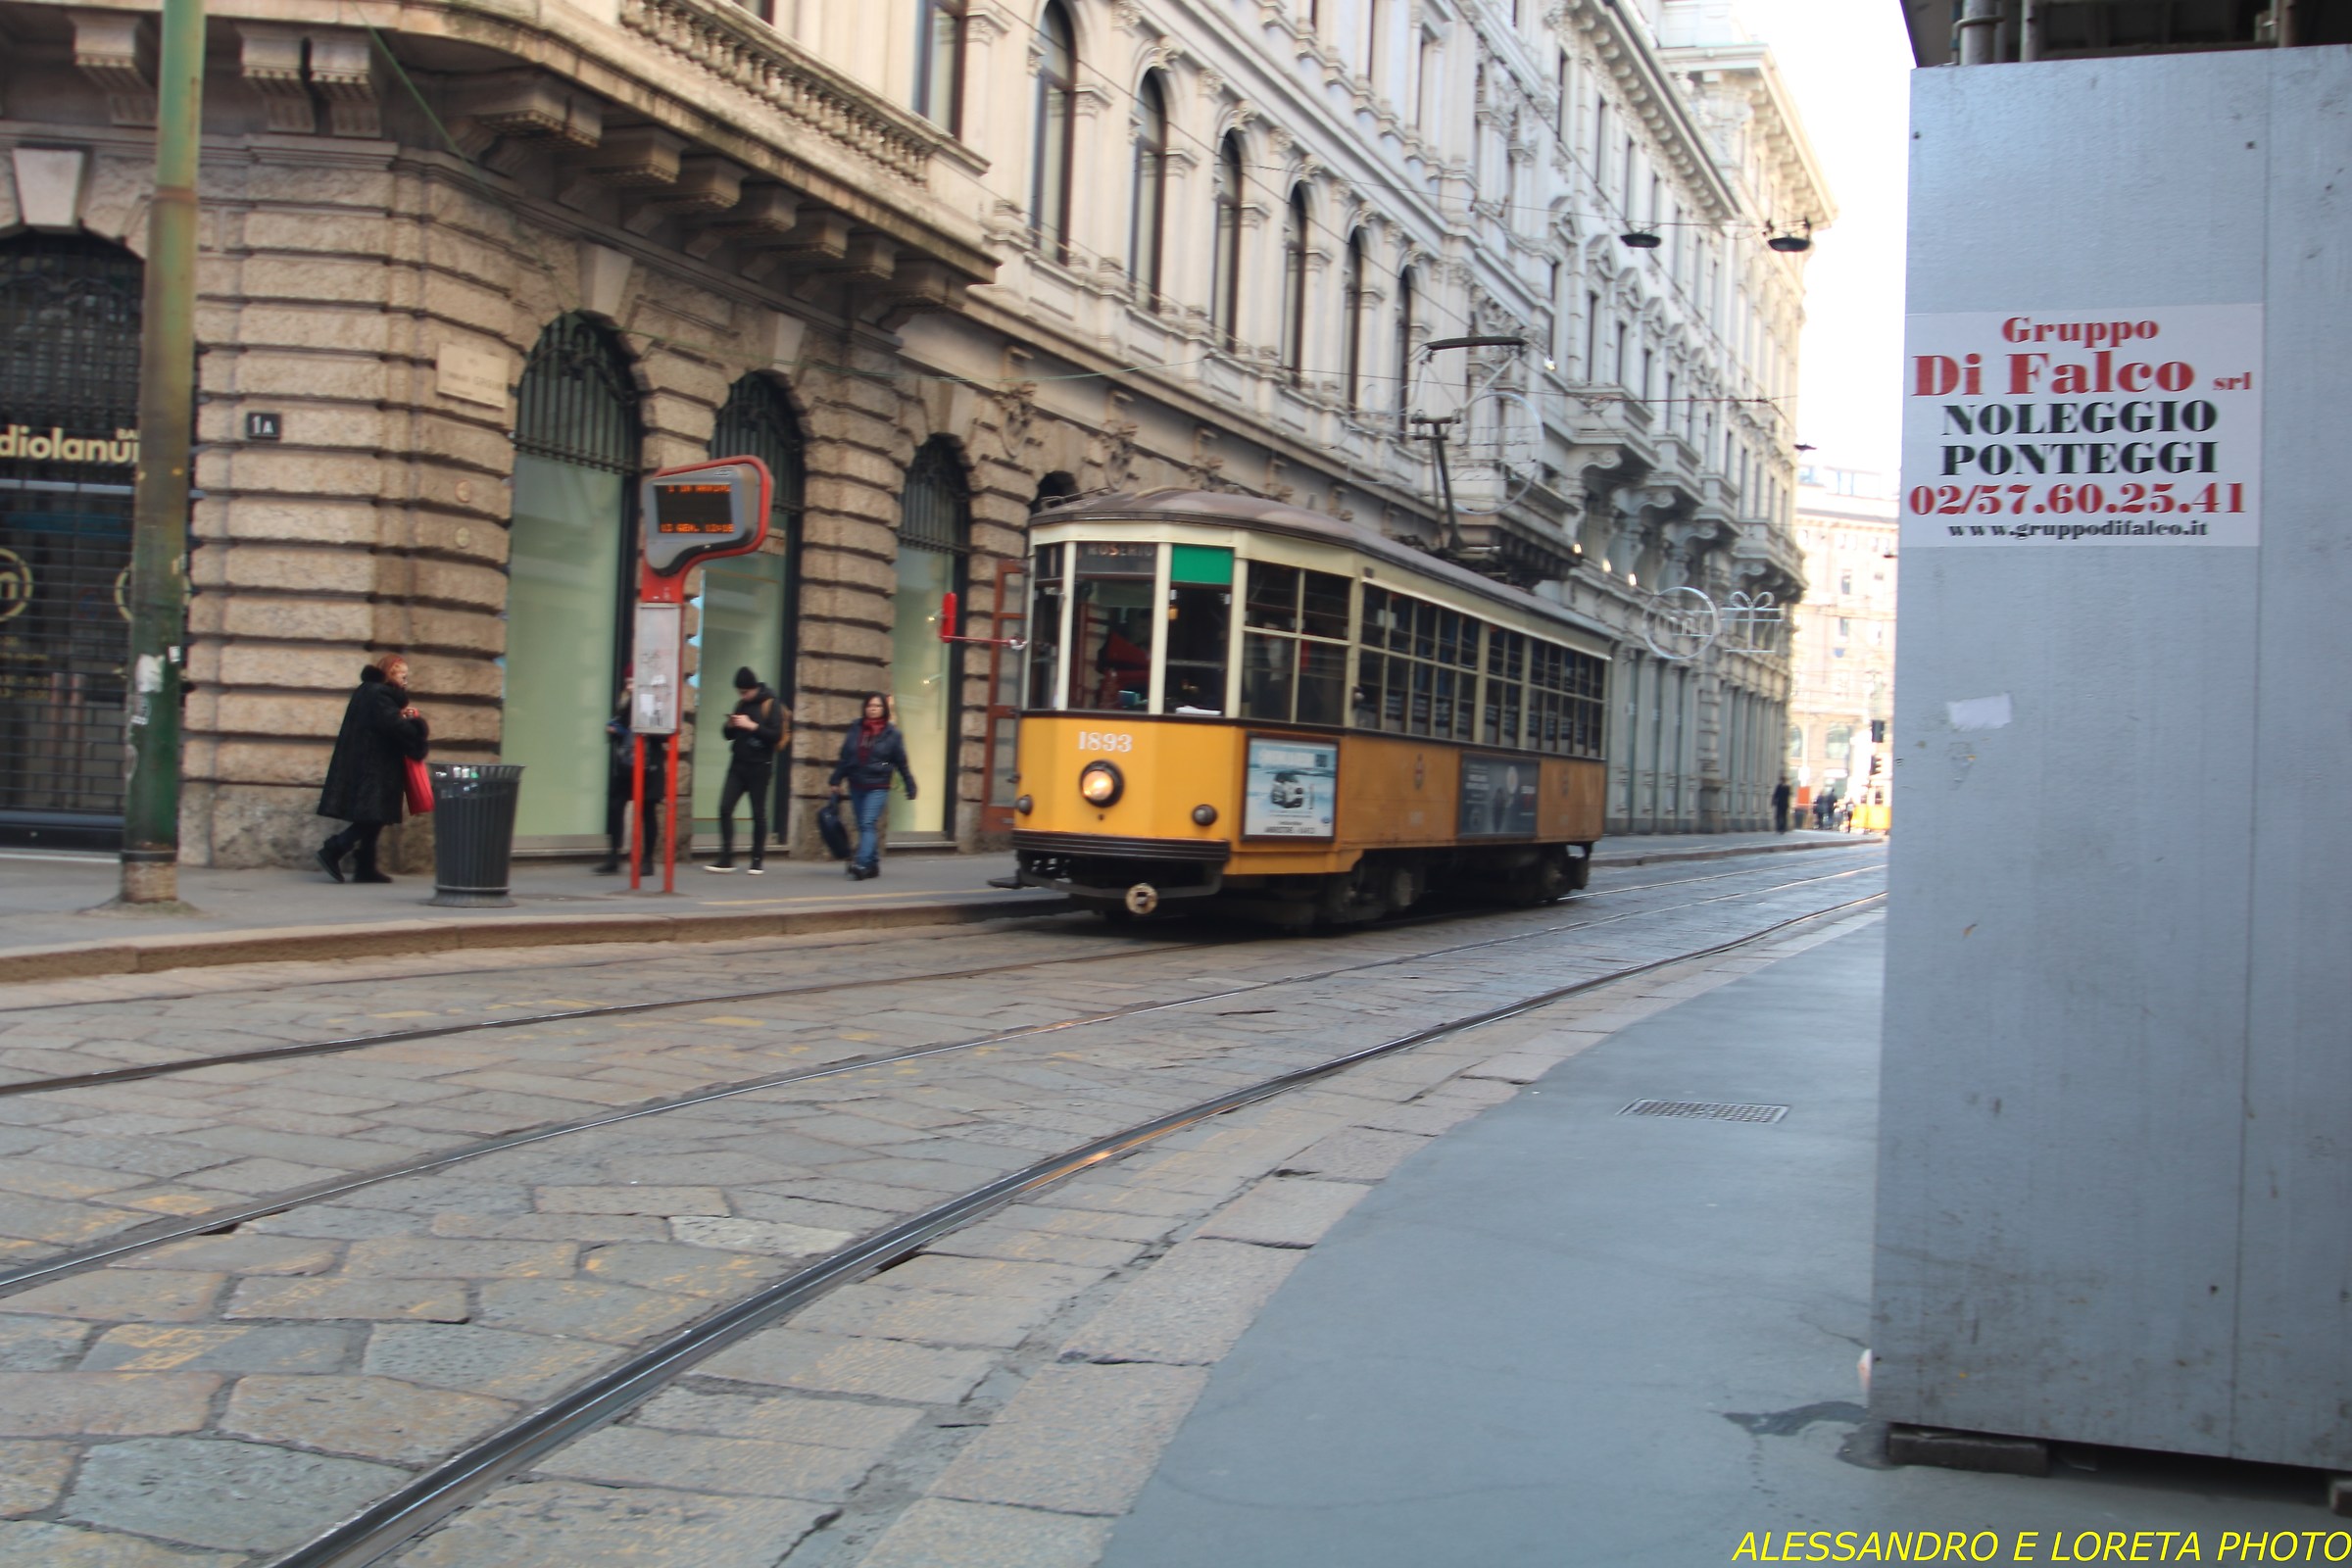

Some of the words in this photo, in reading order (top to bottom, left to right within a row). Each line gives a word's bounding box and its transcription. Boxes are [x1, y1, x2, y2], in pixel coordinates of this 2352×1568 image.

[2002, 317, 2159, 348] Gruppo
[1912, 354, 1983, 396] Di
[2005, 351, 2195, 394] Falco
[2213, 371, 2251, 391] srl
[1942, 400, 2218, 435] NOLEGGIO
[1940, 442, 2219, 475] PONTEGGI
[1909, 483, 2245, 515] 02/57.60.25.41
[1948, 520, 2208, 540] www.gruppodifalco.it
[1078, 731, 1133, 753] 1893
